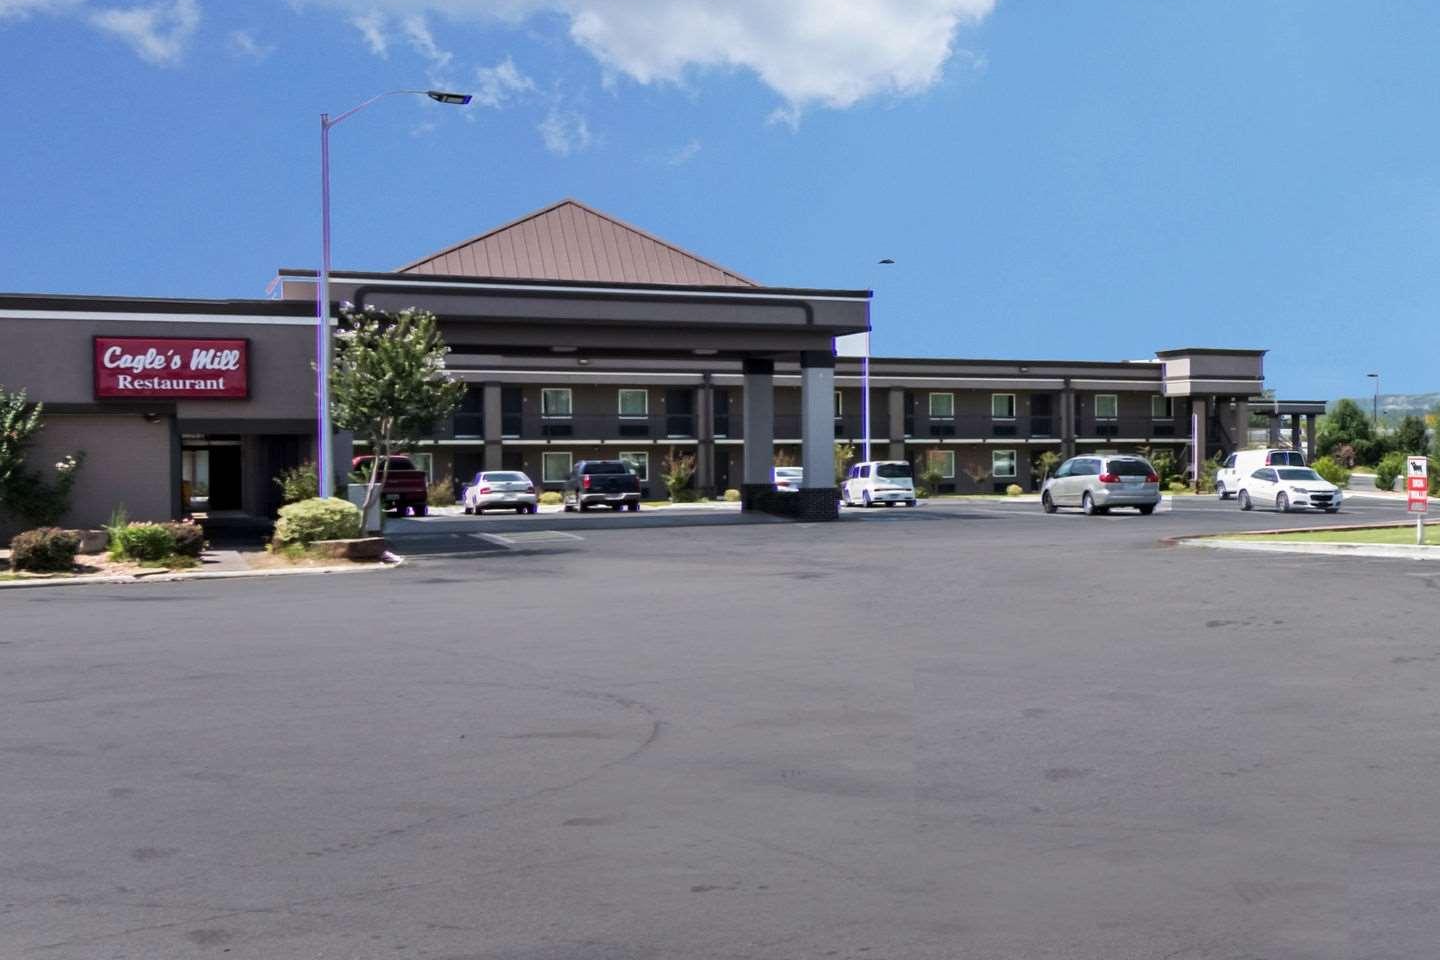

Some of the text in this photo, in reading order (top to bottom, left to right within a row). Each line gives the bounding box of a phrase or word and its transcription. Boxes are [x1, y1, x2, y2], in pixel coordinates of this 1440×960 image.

[103, 345, 241, 374] Cagle's Mill
[117, 374, 226, 390] Restaurant
